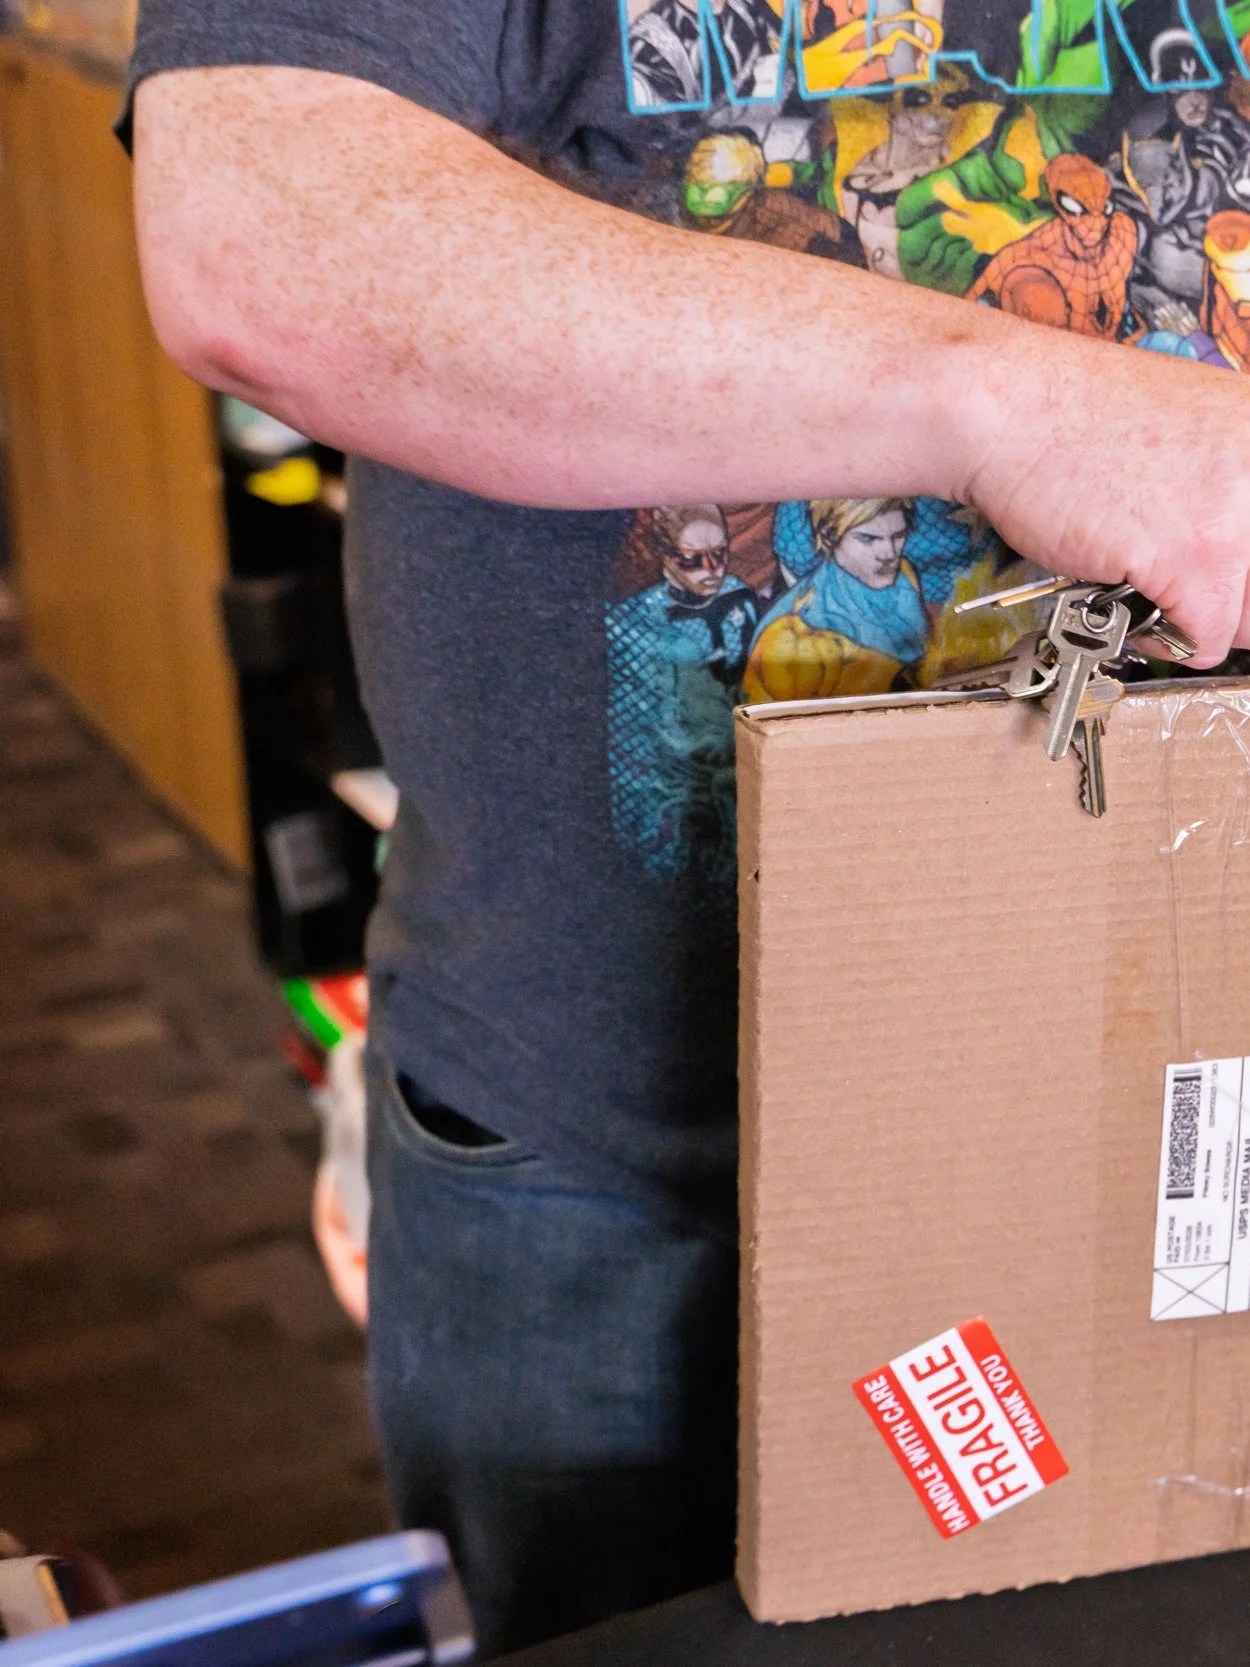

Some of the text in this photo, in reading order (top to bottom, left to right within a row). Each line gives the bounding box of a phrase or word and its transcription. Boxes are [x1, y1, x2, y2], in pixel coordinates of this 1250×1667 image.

[1166, 1215, 1175, 1251] POSTAGE
[1237, 1207, 1249, 1239] USPS
[909, 1344, 1029, 1507] FRAGILE
[980, 1354, 1045, 1450] THANK YOU
[864, 1375, 970, 1534] HANDLE WITH CARE
